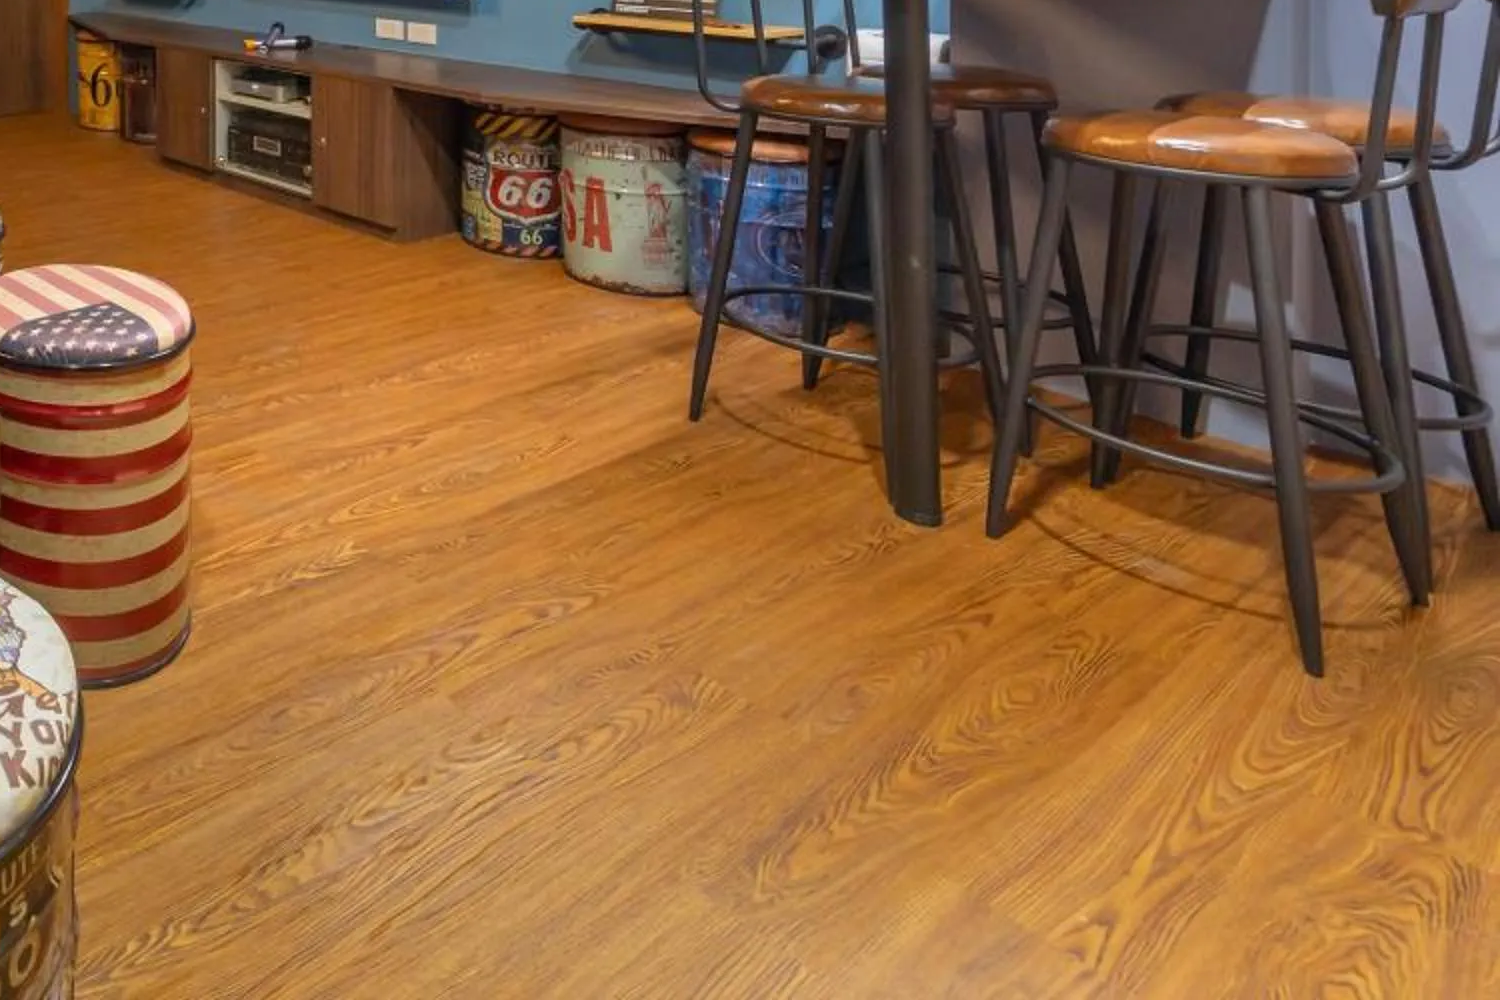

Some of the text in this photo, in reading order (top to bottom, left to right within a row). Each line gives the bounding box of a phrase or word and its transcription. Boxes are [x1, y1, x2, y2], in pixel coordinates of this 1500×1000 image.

[498, 175, 553, 209] 66
[558, 167, 612, 252] SA
[520, 229, 543, 245] 66
